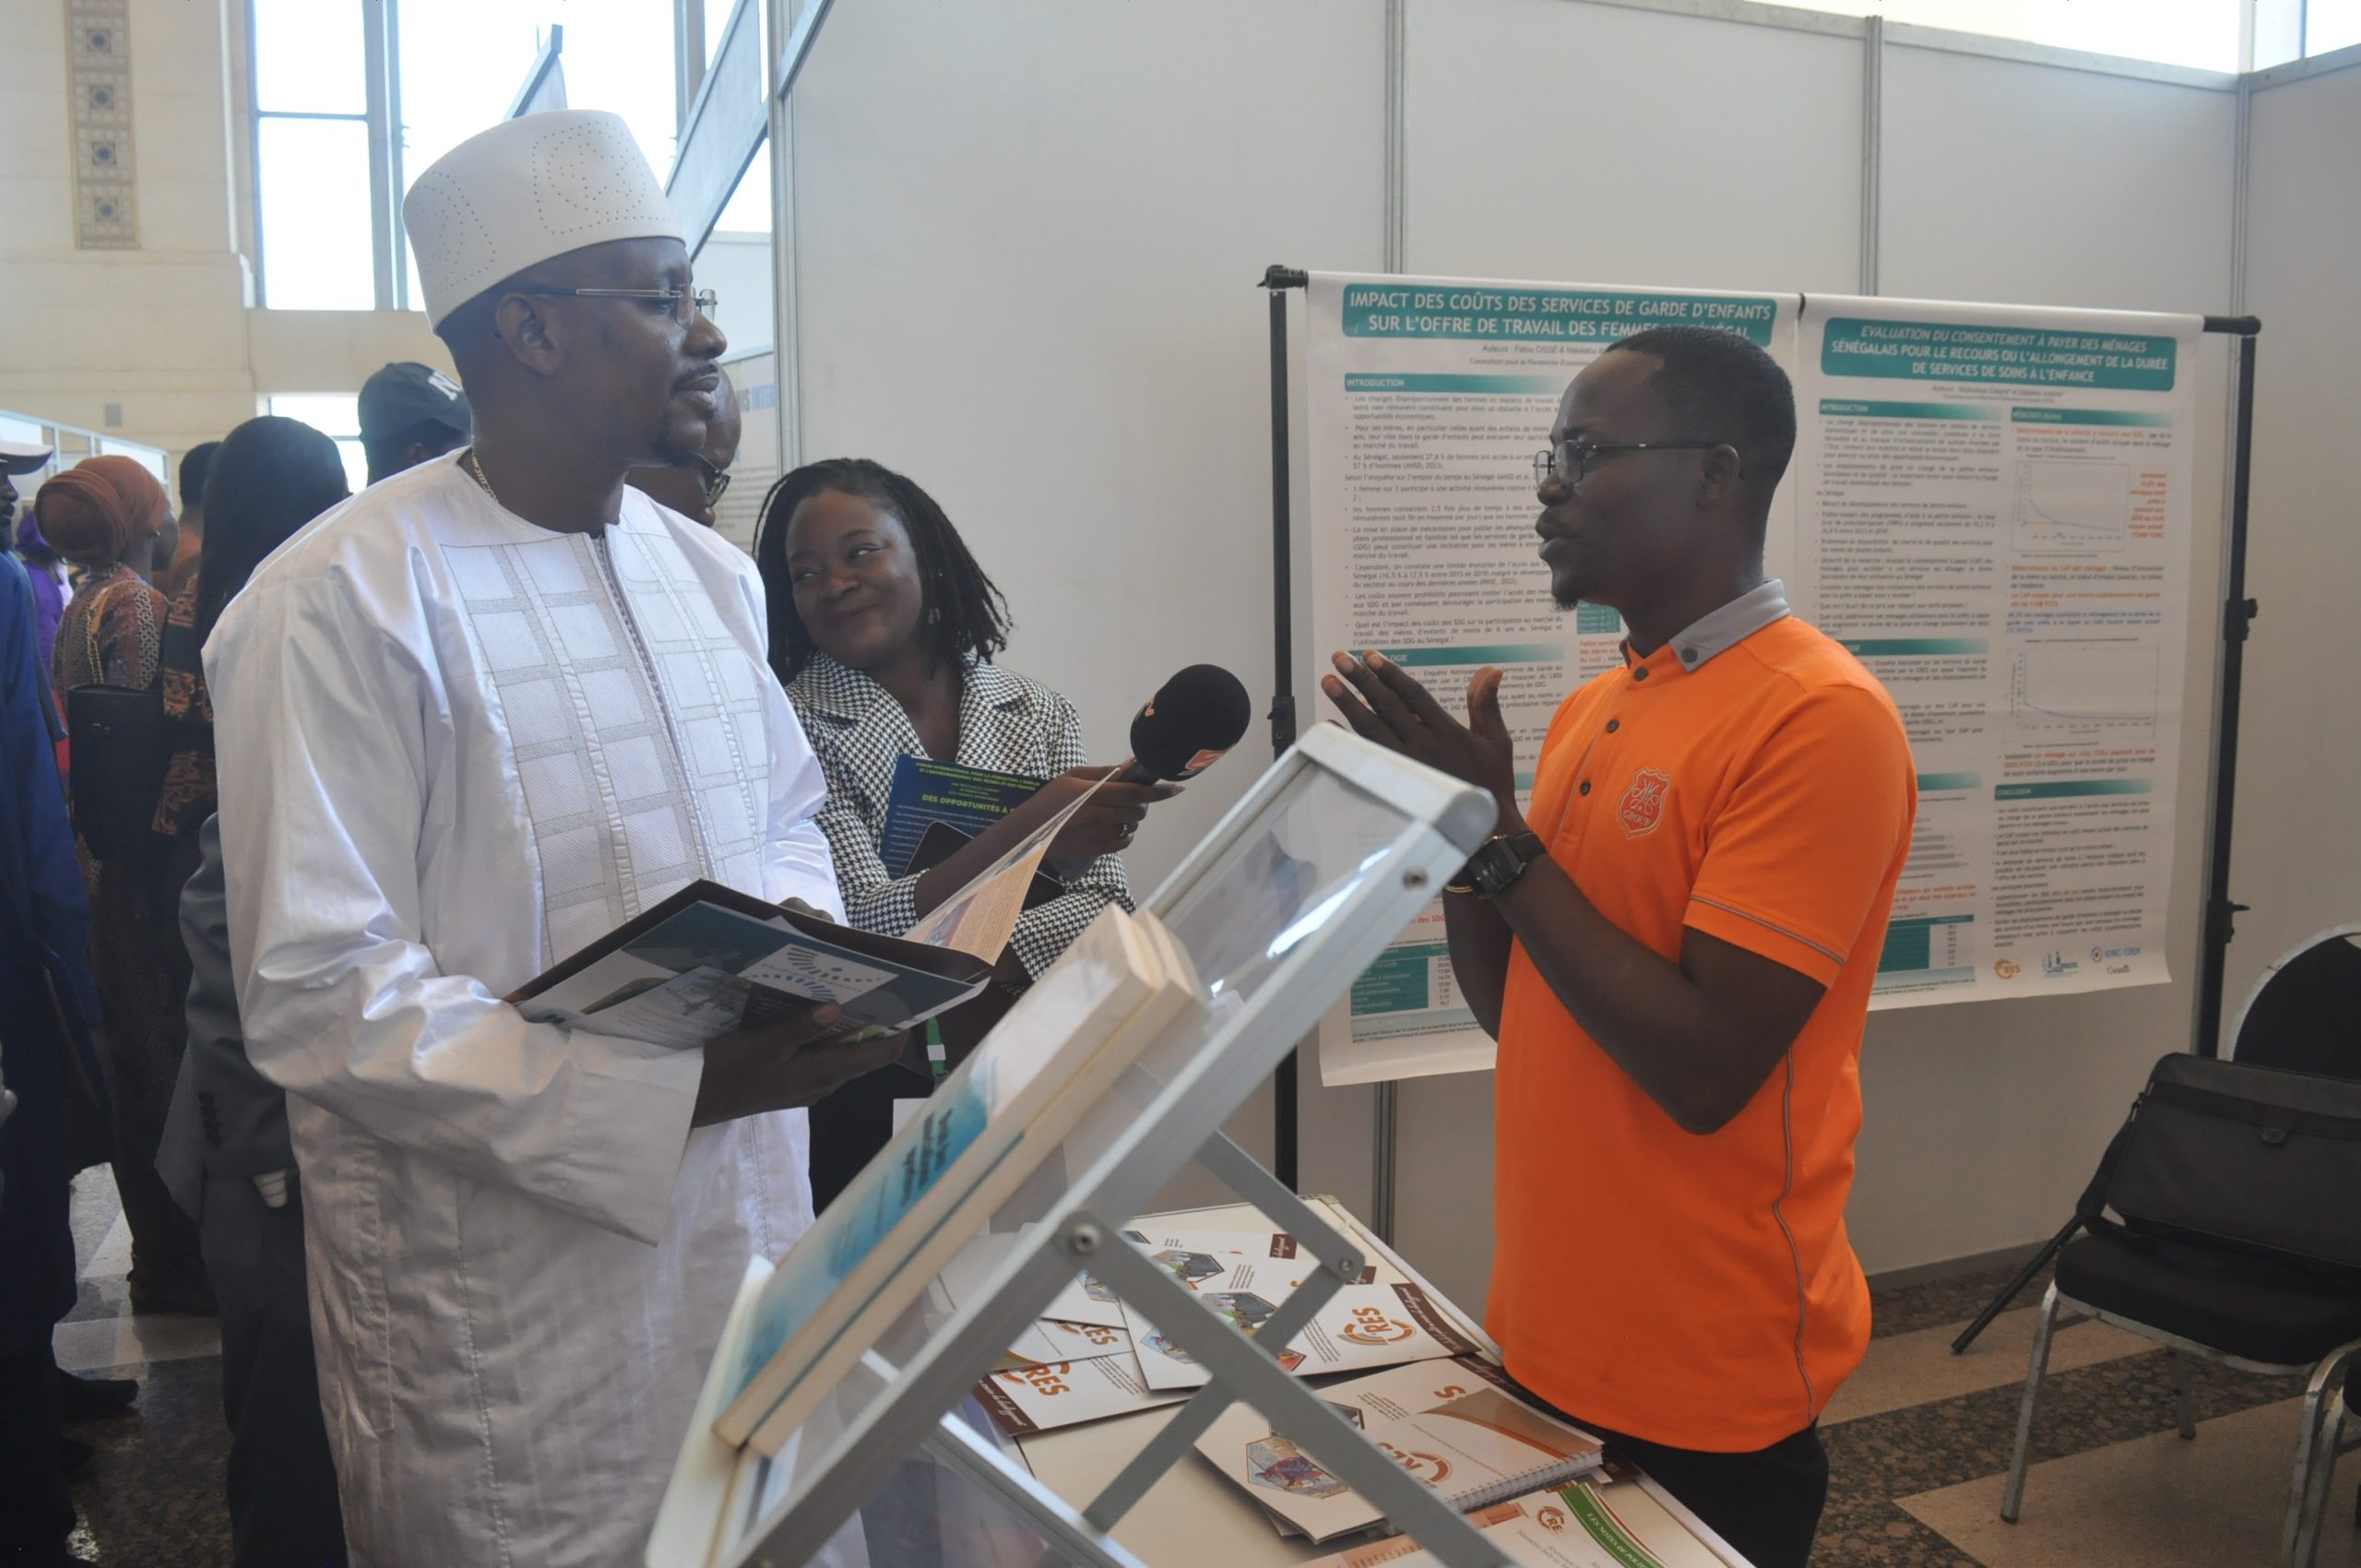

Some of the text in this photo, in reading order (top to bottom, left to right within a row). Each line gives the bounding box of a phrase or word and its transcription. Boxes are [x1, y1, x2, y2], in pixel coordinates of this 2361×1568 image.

[1349, 291, 1771, 320] IMPACT DES COÛTS DES SERVICES DE GARDE D'ENFANTS
[1369, 315, 1400, 331] SUR
[1406, 315, 1472, 333] L'OFFRE
[1477, 318, 1498, 333] DE
[1503, 318, 1564, 336] TRAVAIL
[1569, 320, 1596, 336] DES
[1861, 326, 1930, 340] EVALUATION
[1933, 329, 1949, 341] DU
[1952, 331, 2035, 346] CONSENTEMENT
[2048, 336, 2079, 349] PAYER
[2080, 338, 2099, 350] DES
[2102, 339, 2147, 353] MÉNAGES
[1832, 339, 2168, 370] SÉNÉGALAIS POUR LE RECOURS OU L'ALLONGEMENT DE LA DURÉE
[1347, 379, 1405, 387] INTRODUCTION
[1912, 362, 1927, 374] DE
[1929, 362, 1978, 376] SERVICES
[1982, 365, 1997, 377] DE
[1999, 366, 2027, 379] SOINS
[2039, 368, 2095, 383] L'ENFANCE
[1821, 404, 1869, 412] INTRODUCTION
[922, 794, 1009, 814] DES OPPORTUNITÉS À
